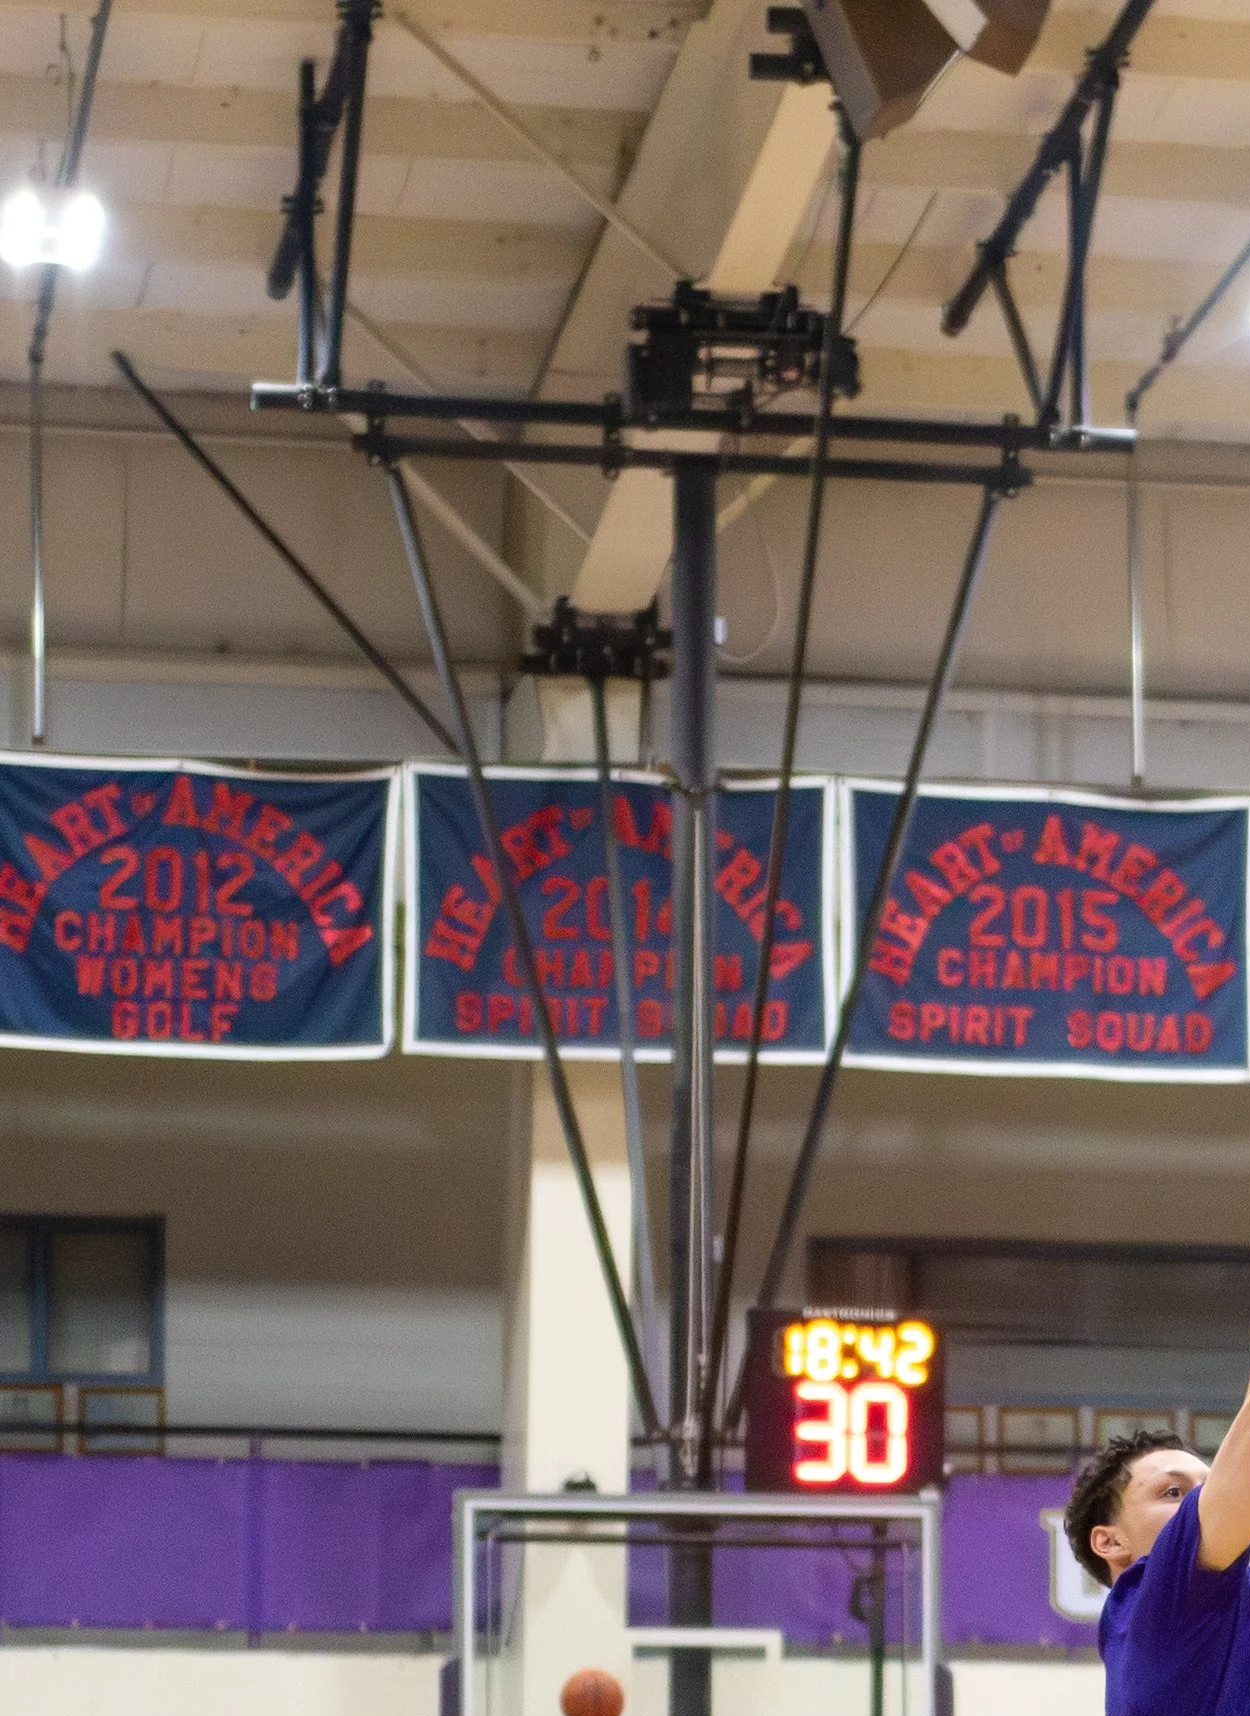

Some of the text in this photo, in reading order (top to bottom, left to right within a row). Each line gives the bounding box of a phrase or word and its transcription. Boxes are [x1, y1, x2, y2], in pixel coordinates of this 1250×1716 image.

[99, 845, 256, 917] 2012
[162, 773, 374, 967] AMERICA
[54, 910, 299, 961] CHAMPION
[868, 821, 1002, 987] HEART
[1031, 814, 1237, 1000] AMERICA
[968, 882, 1121, 953] 2015
[937, 946, 1168, 997] CHAMPION
[111, 999, 241, 1043] GOLF
[887, 998, 1214, 1054] SPIRIT SQUAD
[783, 1317, 934, 1387] 18:42
[793, 1378, 910, 1486] 30
